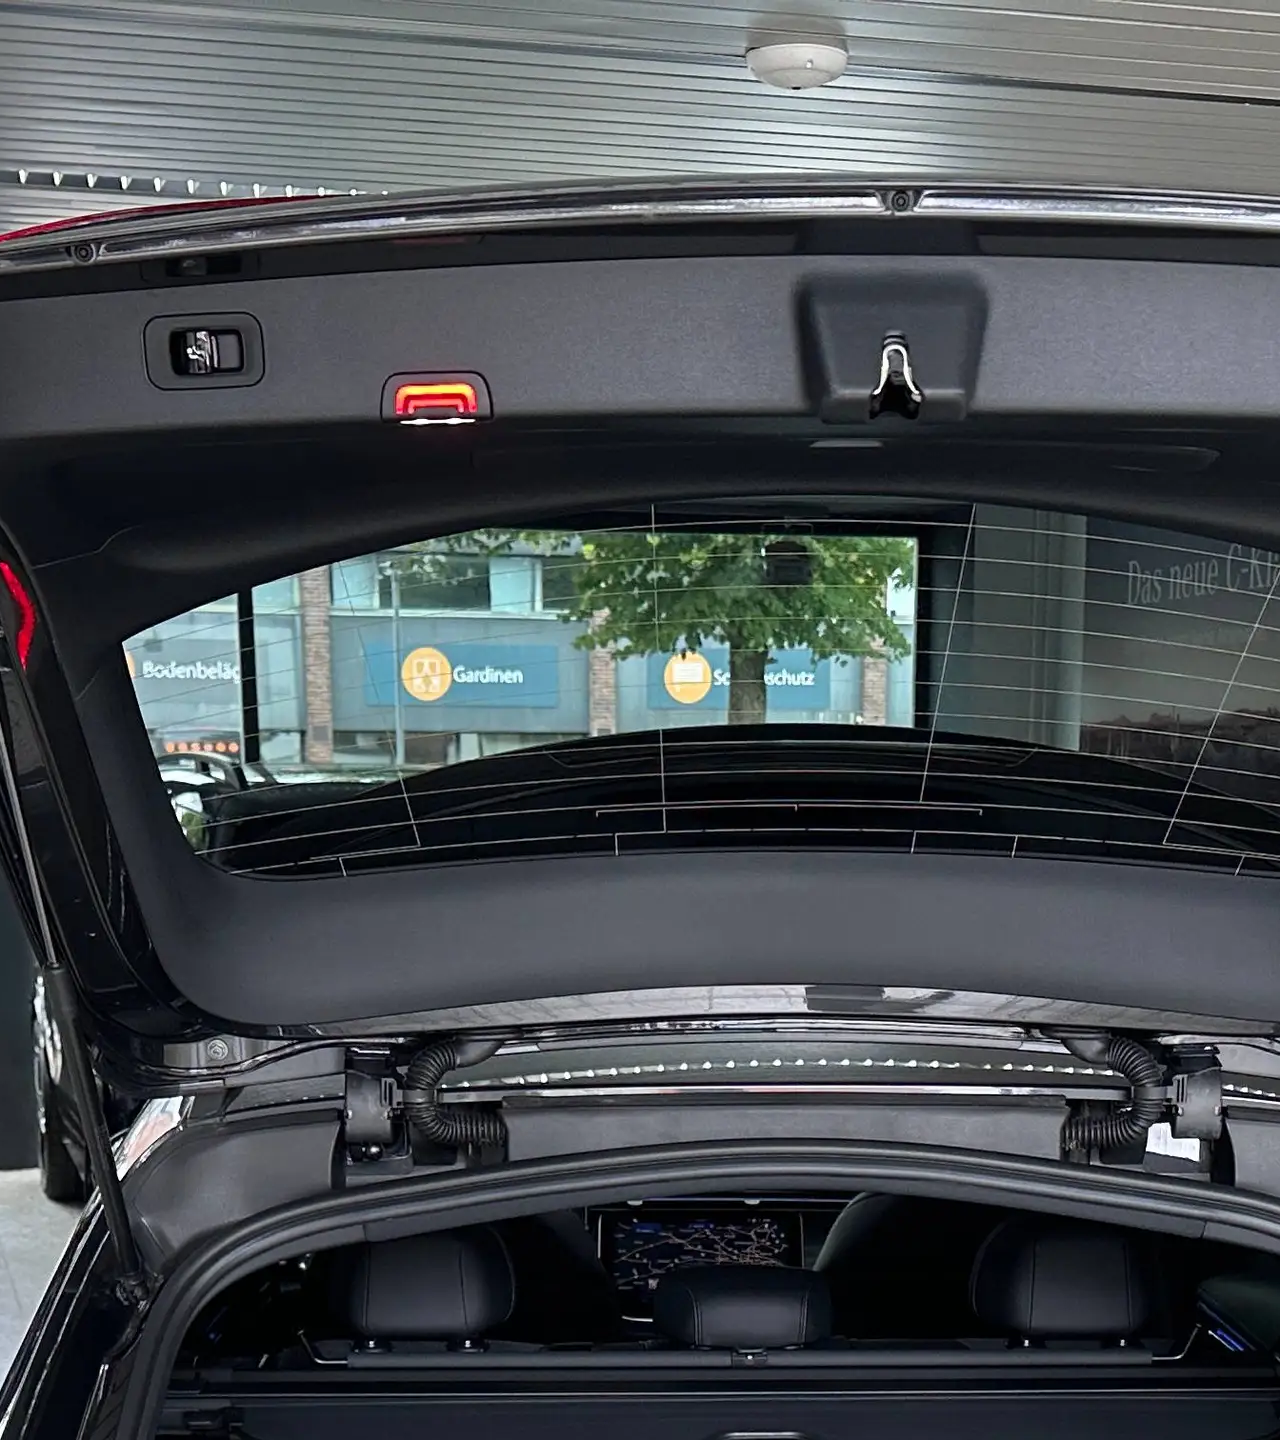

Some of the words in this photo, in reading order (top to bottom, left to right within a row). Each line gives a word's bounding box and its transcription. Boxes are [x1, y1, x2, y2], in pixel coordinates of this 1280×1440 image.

[1128, 560, 1163, 604] Das
[1168, 558, 1220, 600] neue
[142, 660, 241, 684] Bodenbeläg
[452, 664, 524, 684] Gardinen
